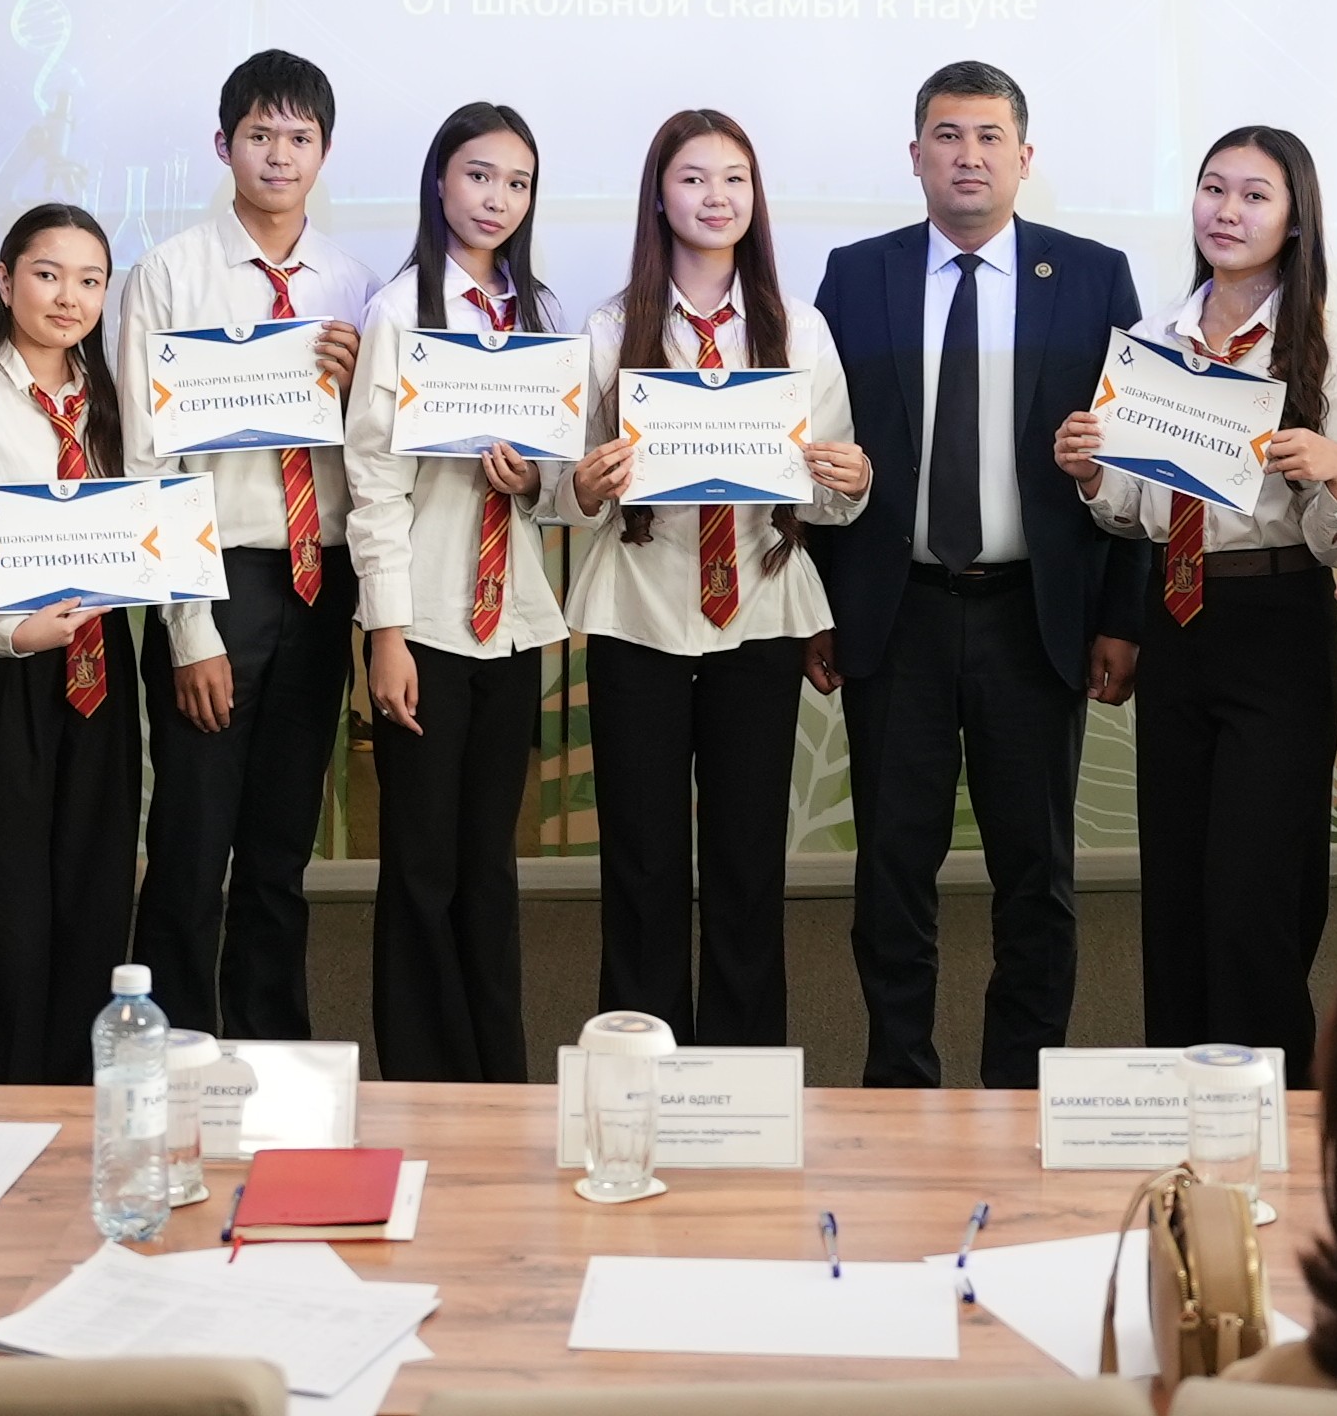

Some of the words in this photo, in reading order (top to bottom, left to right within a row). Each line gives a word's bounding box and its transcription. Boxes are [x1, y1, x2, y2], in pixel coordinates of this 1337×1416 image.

[180, 390, 312, 413] СЕРТИФИКАТЫ
[423, 400, 555, 417] СЕРТИФИКАТЫ
[1176, 402, 1206, 419] БІЛІМ
[1116, 406, 1242, 459] СЕРТИФИКАТЫ
[648, 442, 782, 455] СЕРТИФИКАТЫ
[0, 550, 137, 569] СЕРТИФИКАТЫ
[202, 1083, 254, 1097] ЛЕКСЕЙ
